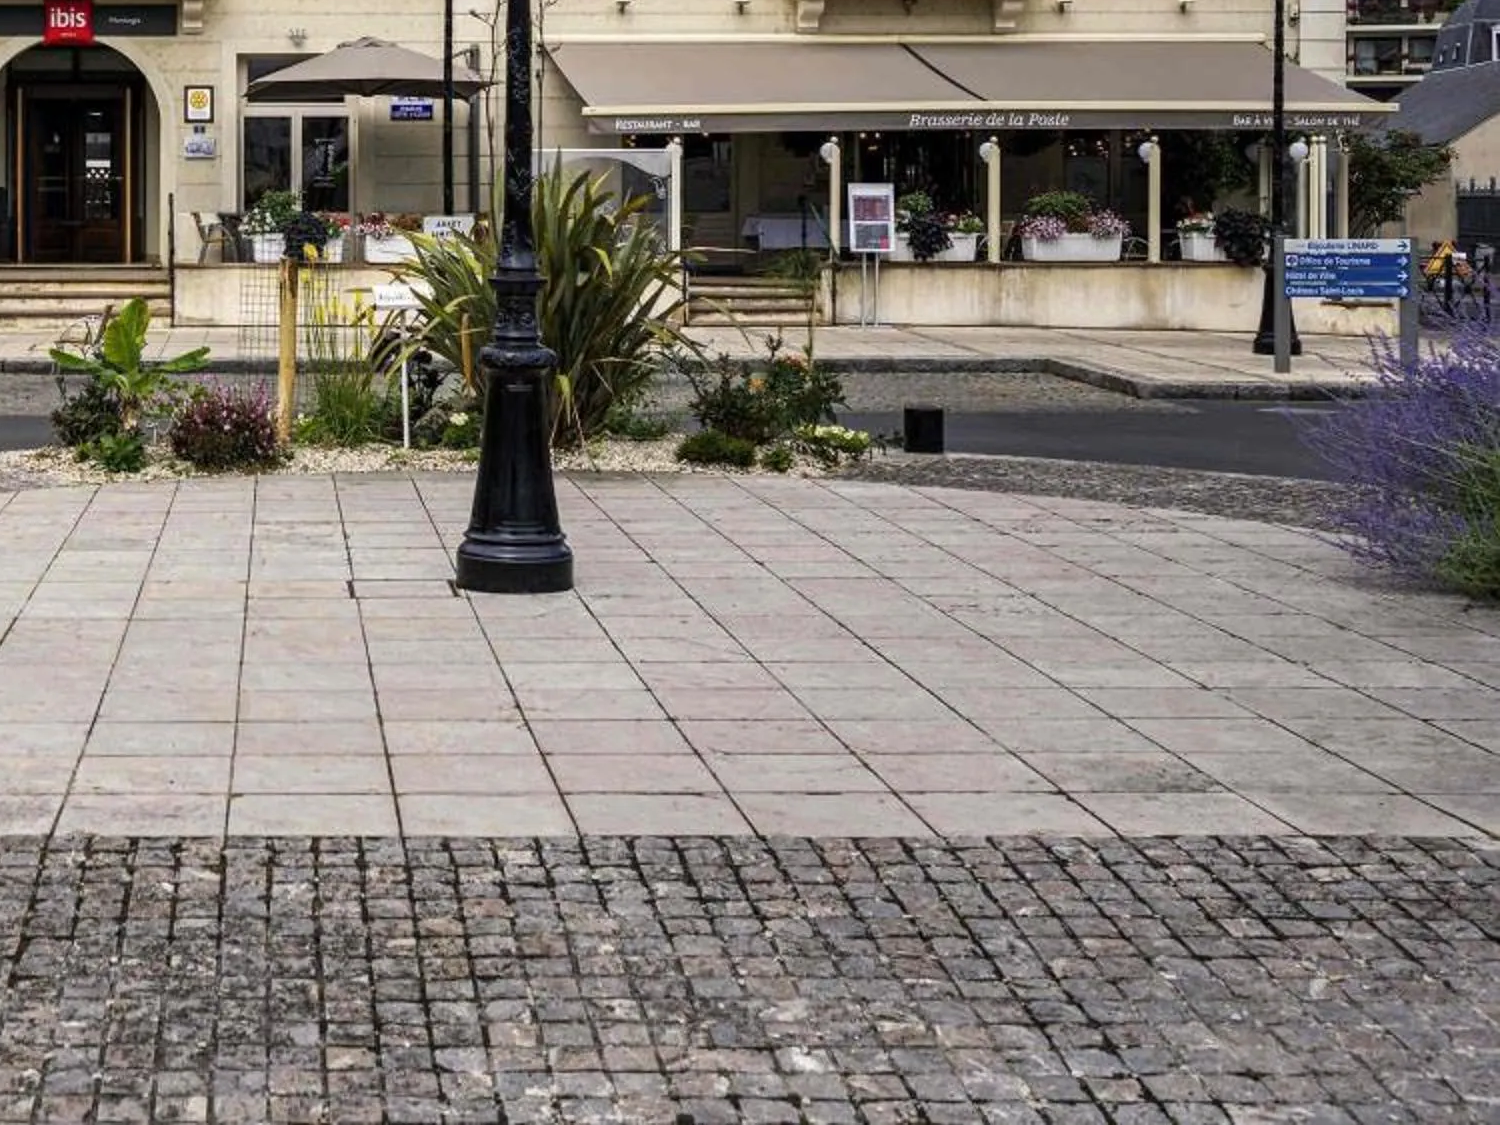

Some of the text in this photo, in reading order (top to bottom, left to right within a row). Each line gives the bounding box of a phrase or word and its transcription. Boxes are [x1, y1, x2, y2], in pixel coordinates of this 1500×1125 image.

[49, 7, 87, 28] ibis
[909, 113, 1070, 127] Brasserie de la Poste
